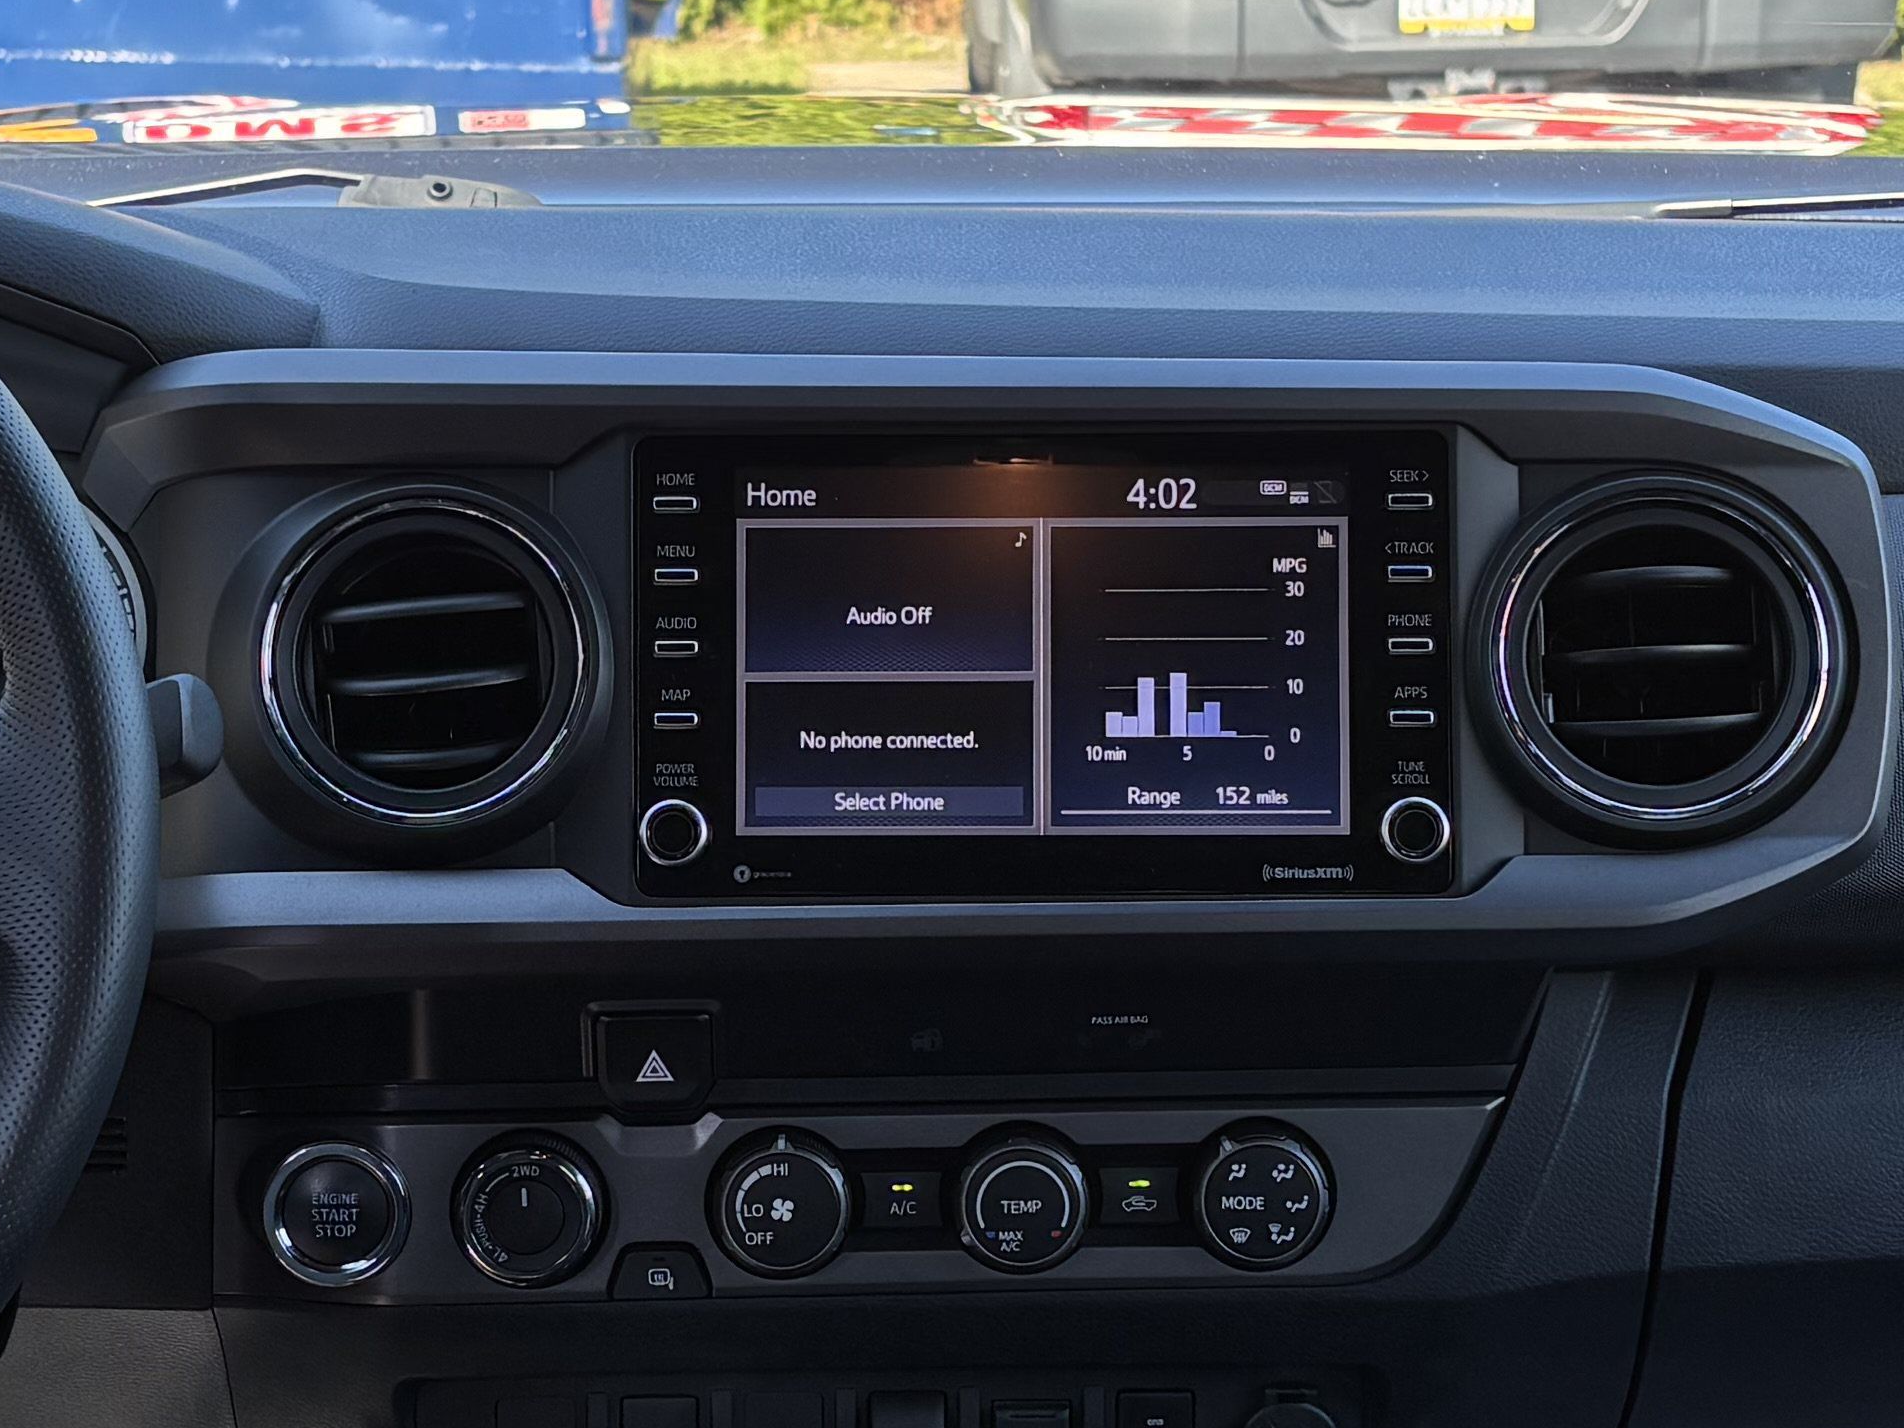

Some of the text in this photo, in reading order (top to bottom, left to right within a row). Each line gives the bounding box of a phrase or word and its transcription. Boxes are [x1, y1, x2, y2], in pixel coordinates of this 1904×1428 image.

[654, 472, 697, 488] HOME
[1388, 469, 1420, 483] SEEK
[745, 481, 818, 509] Home
[1126, 476, 1199, 511] 4:02
[655, 544, 696, 559] MENU
[1393, 541, 1435, 555] TRACK
[1271, 557, 1308, 575] MPG
[1284, 581, 1306, 599] 30
[654, 615, 698, 630] AUDIO
[845, 604, 933, 627] Audio Off
[1386, 613, 1434, 628] PHONE
[1284, 629, 1306, 647] 20
[1285, 678, 1305, 695] 10
[1393, 685, 1429, 700] APPS
[660, 687, 693, 702] MAP
[799, 729, 981, 756] No phone connected.
[1289, 727, 1302, 744] 0
[1181, 745, 1193, 763] 5
[1263, 745, 1276, 763] 0
[654, 762, 696, 776] POWER
[1396, 760, 1427, 773] TUNE
[652, 774, 699, 789] VOLUME
[1390, 772, 1431, 786] SCROLL
[833, 791, 945, 813] Select Phone
[1126, 785, 1290, 811] Range 152 miles
[511, 1164, 541, 1178] 2WD
[772, 1162, 789, 1177] HI
[312, 1192, 359, 1206] ENGINE
[1000, 1198, 1043, 1214] TEMP
[1220, 1194, 1266, 1212] MODE
[311, 1208, 360, 1223] START
[743, 1203, 765, 1218] LO
[889, 1199, 918, 1217] A/C
[315, 1223, 357, 1239] STOP
[745, 1231, 775, 1246] OFF
[998, 1230, 1024, 1241] MAX
[1000, 1240, 1021, 1252] A/C
